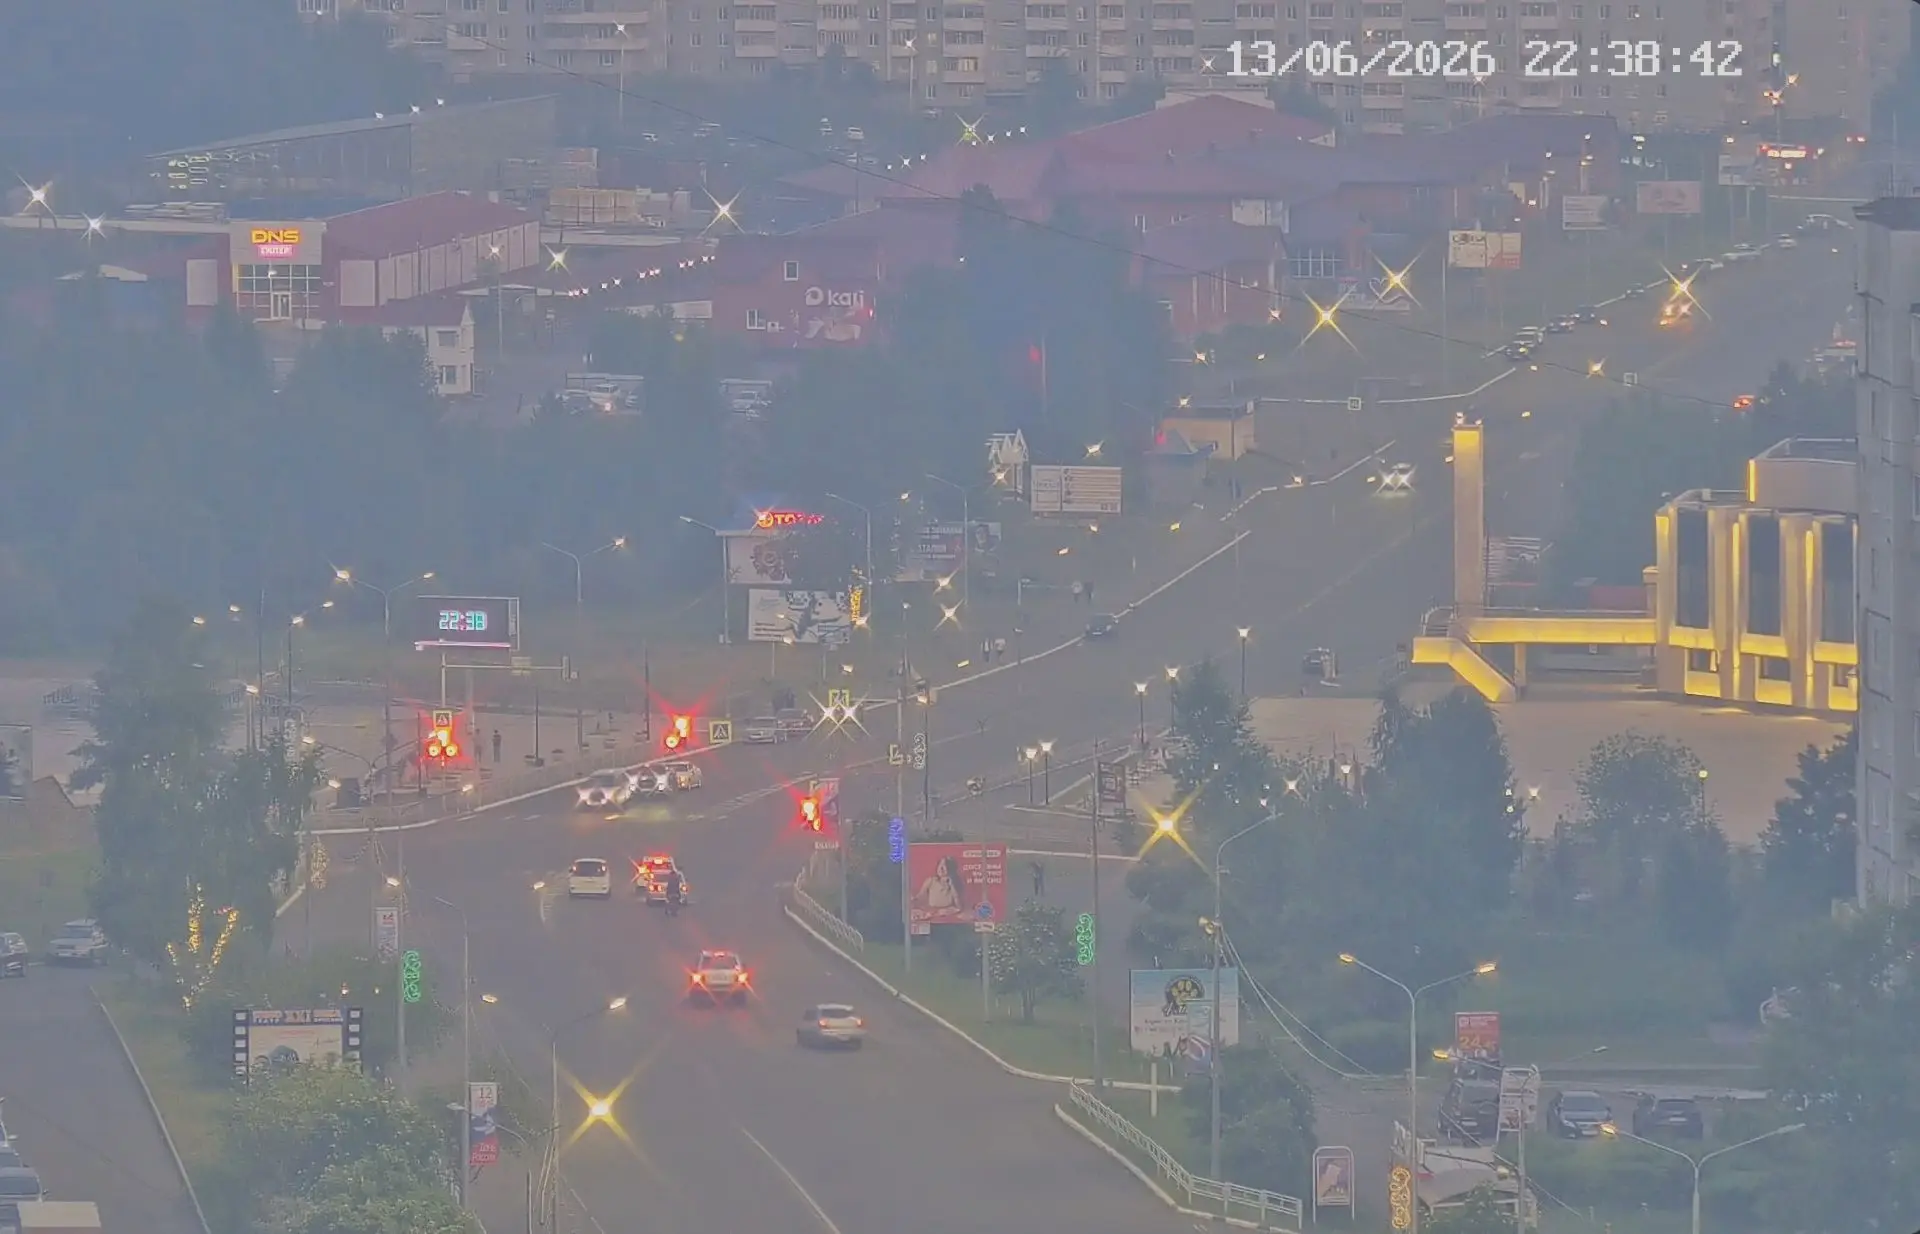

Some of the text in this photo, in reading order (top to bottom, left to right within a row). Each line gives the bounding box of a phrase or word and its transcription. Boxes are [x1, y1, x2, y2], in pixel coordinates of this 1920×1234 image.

[251, 229, 299, 244] DNS
[827, 289, 865, 308] kari
[439, 610, 487, 631] 22:38
[479, 1087, 492, 1099] 12
